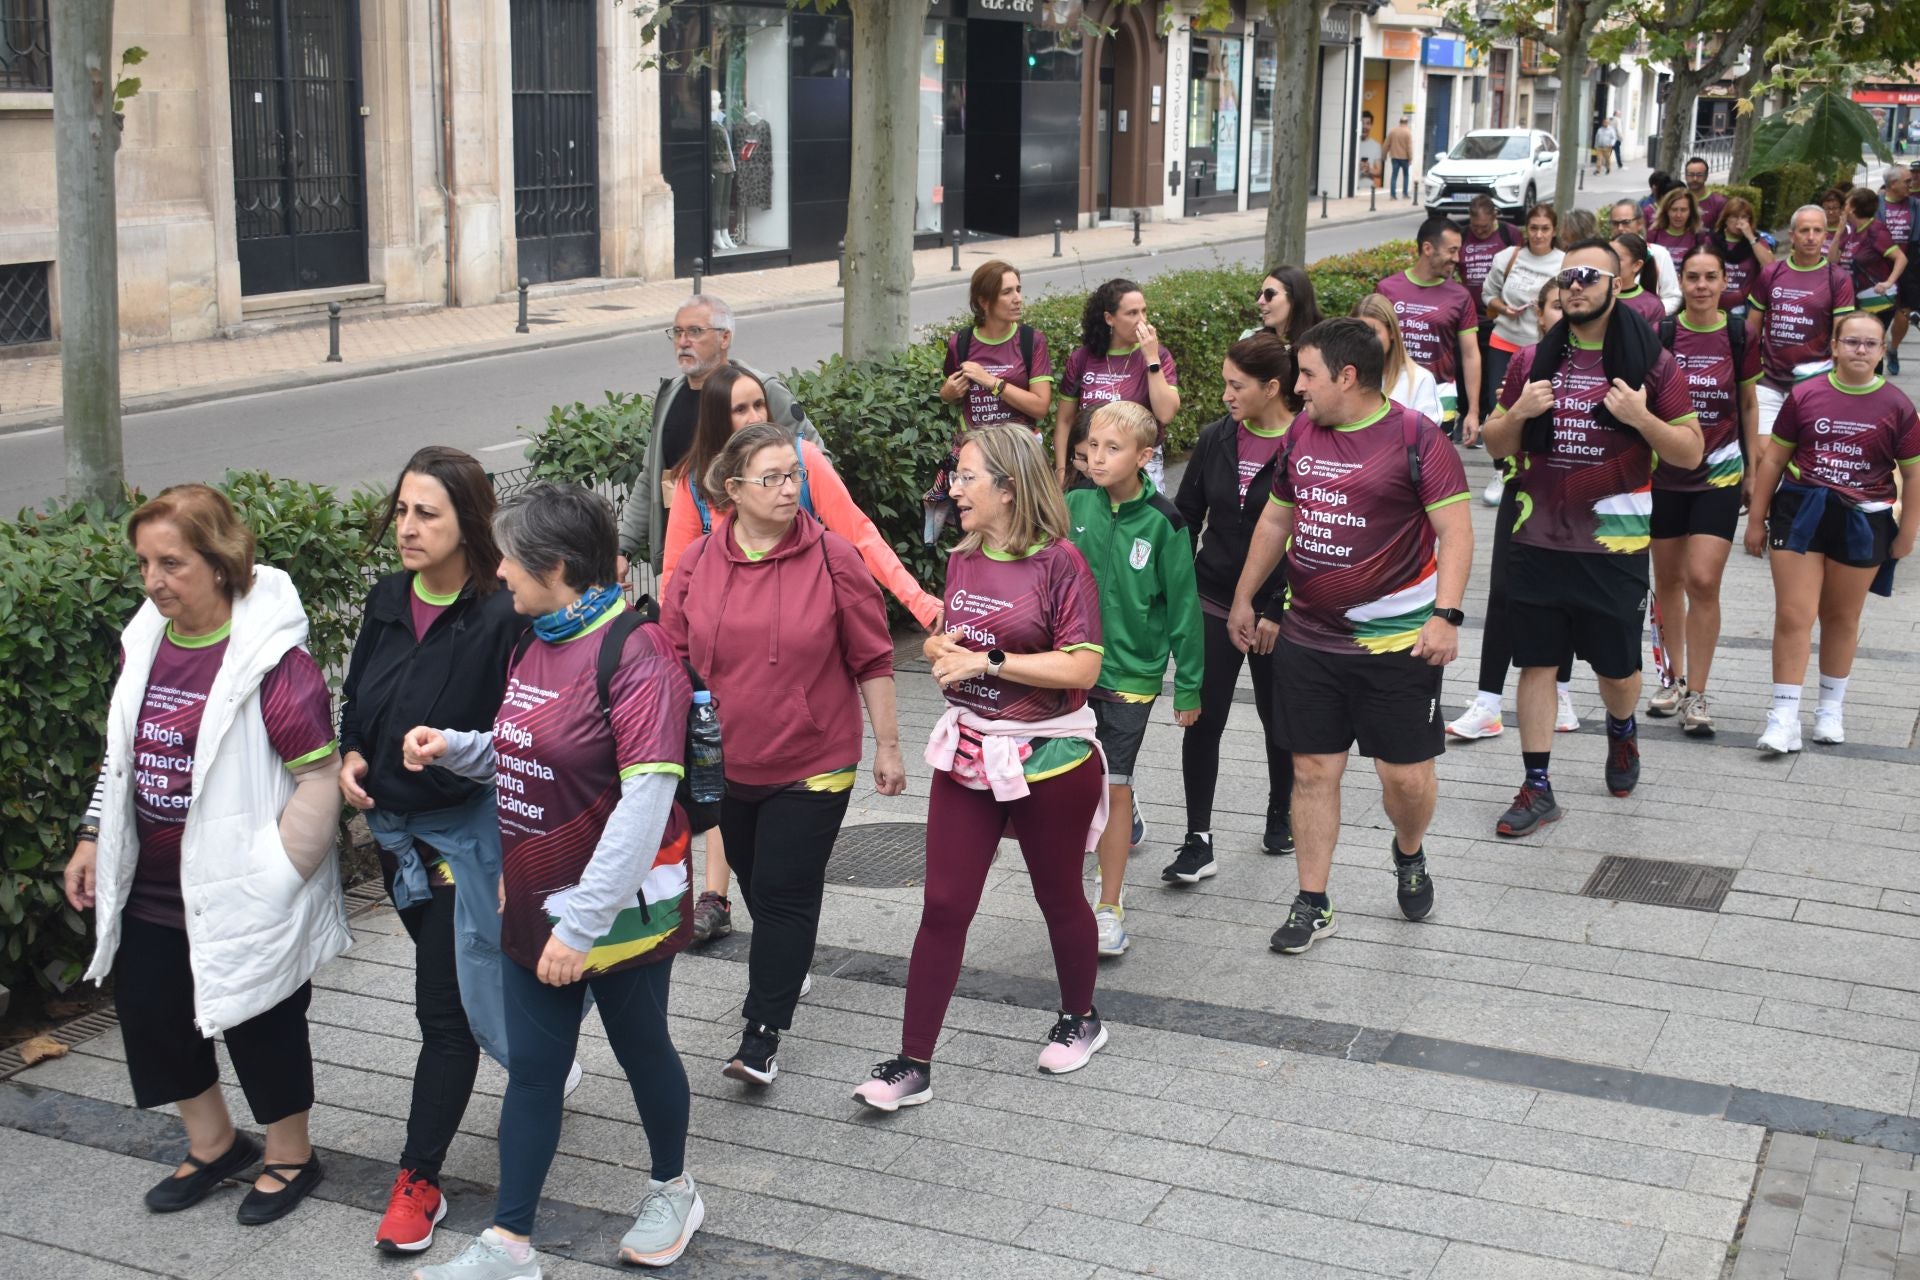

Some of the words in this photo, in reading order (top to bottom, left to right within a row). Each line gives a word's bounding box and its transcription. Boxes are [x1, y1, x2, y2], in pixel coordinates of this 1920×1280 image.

[1172, 47, 1183, 152] ameyugo
[1782, 303, 1804, 314] Rioja
[1406, 319, 1429, 331] Rioja
[1781, 315, 1814, 325] marcha
[1406, 332, 1440, 343] marcha
[1777, 330, 1805, 340] cáncer
[1688, 375, 1717, 387] Rioja
[970, 394, 981, 403] En
[1082, 390, 1093, 399] La
[1689, 390, 1729, 399] marcha
[971, 403, 999, 413] contra
[972, 413, 980, 422] el
[982, 412, 1011, 421] cáncer
[1558, 442, 1605, 456] cáncer
[1814, 440, 1829, 451] La
[1833, 442, 1862, 456] Rioja
[1830, 458, 1871, 470] marcha
[1295, 485, 1308, 499] La
[1311, 487, 1347, 506] Rioja
[1311, 510, 1366, 528] marcha
[1297, 521, 1332, 539] contra
[1304, 538, 1353, 557] cáncer
[962, 624, 996, 646] Rioja
[958, 679, 1001, 701] cáncer
[142, 722, 184, 747] Rioja
[500, 721, 533, 749] Rioja
[139, 752, 195, 773] march
[502, 753, 555, 780] marcha
[135, 770, 169, 789] ntra
[501, 793, 545, 820] cáncer
